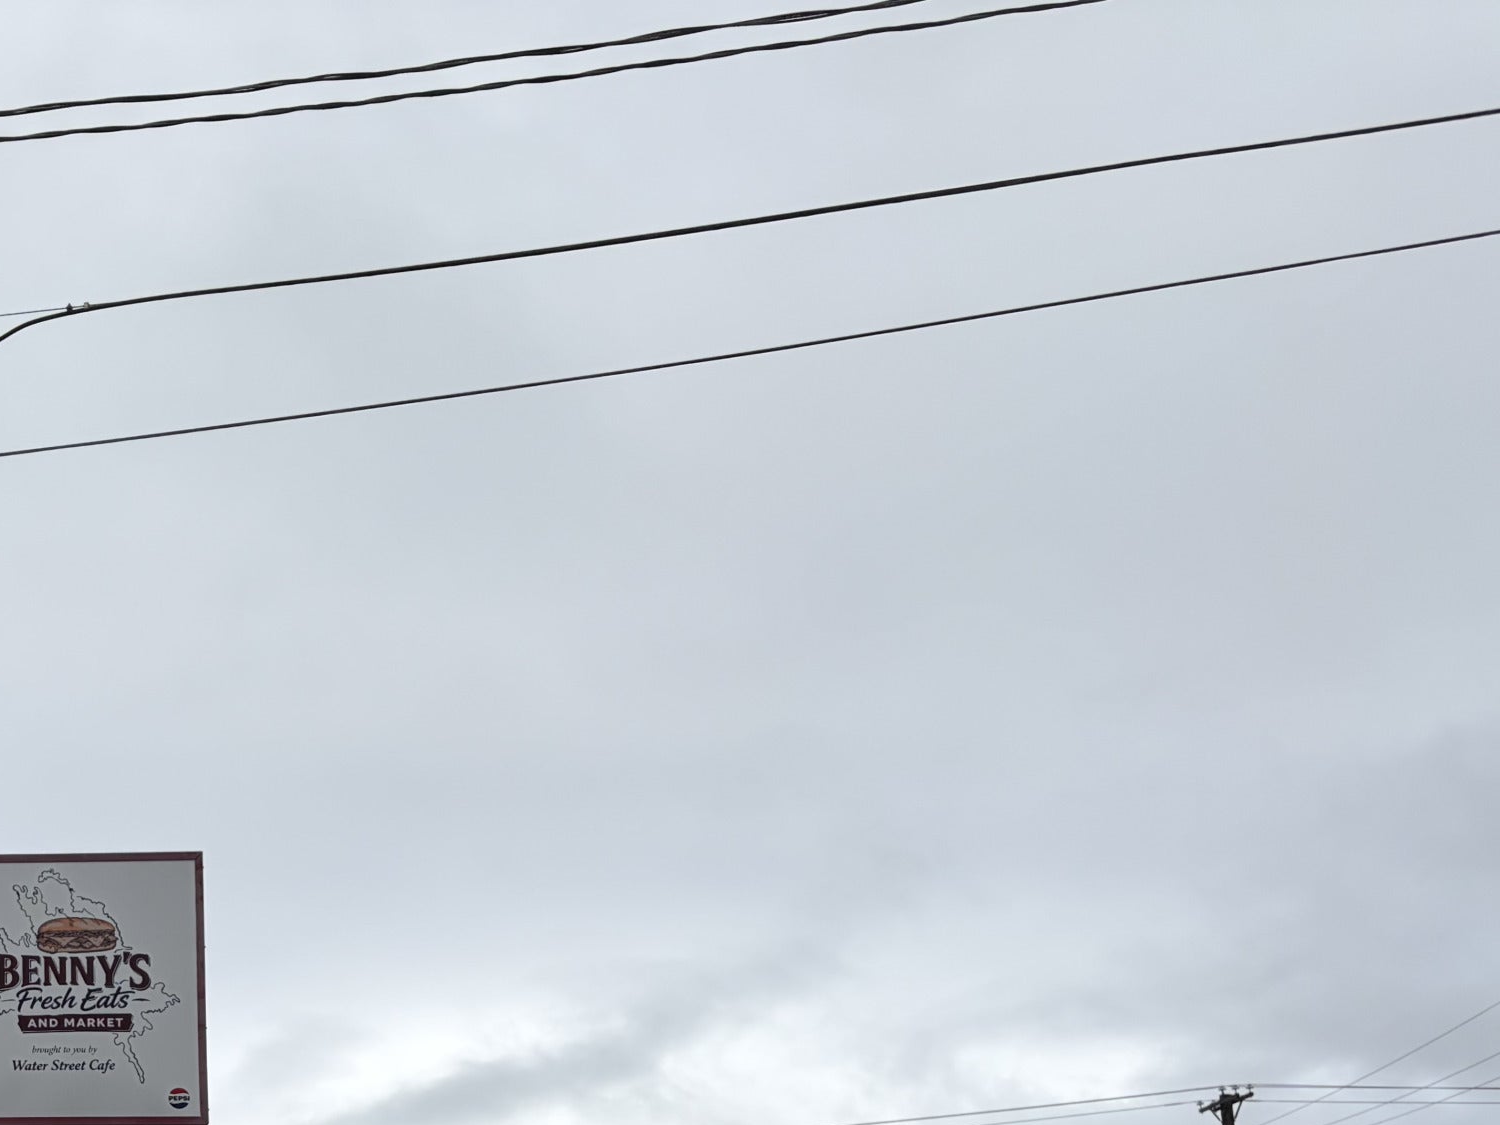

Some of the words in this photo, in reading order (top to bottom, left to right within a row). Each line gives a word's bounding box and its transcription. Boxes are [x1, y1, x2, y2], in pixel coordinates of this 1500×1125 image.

[16, 986, 77, 1013] Fresh
[79, 985, 136, 1012] Eats
[27, 1017, 59, 1029] AND
[64, 1016, 124, 1028] MARKET
[31, 1044, 61, 1056] brought
[63, 1046, 71, 1054] to
[72, 1047, 87, 1056] you
[88, 1045, 98, 1056] by
[12, 1059, 49, 1072] Water
[51, 1059, 86, 1072] Street
[88, 1058, 116, 1074] Cafe
